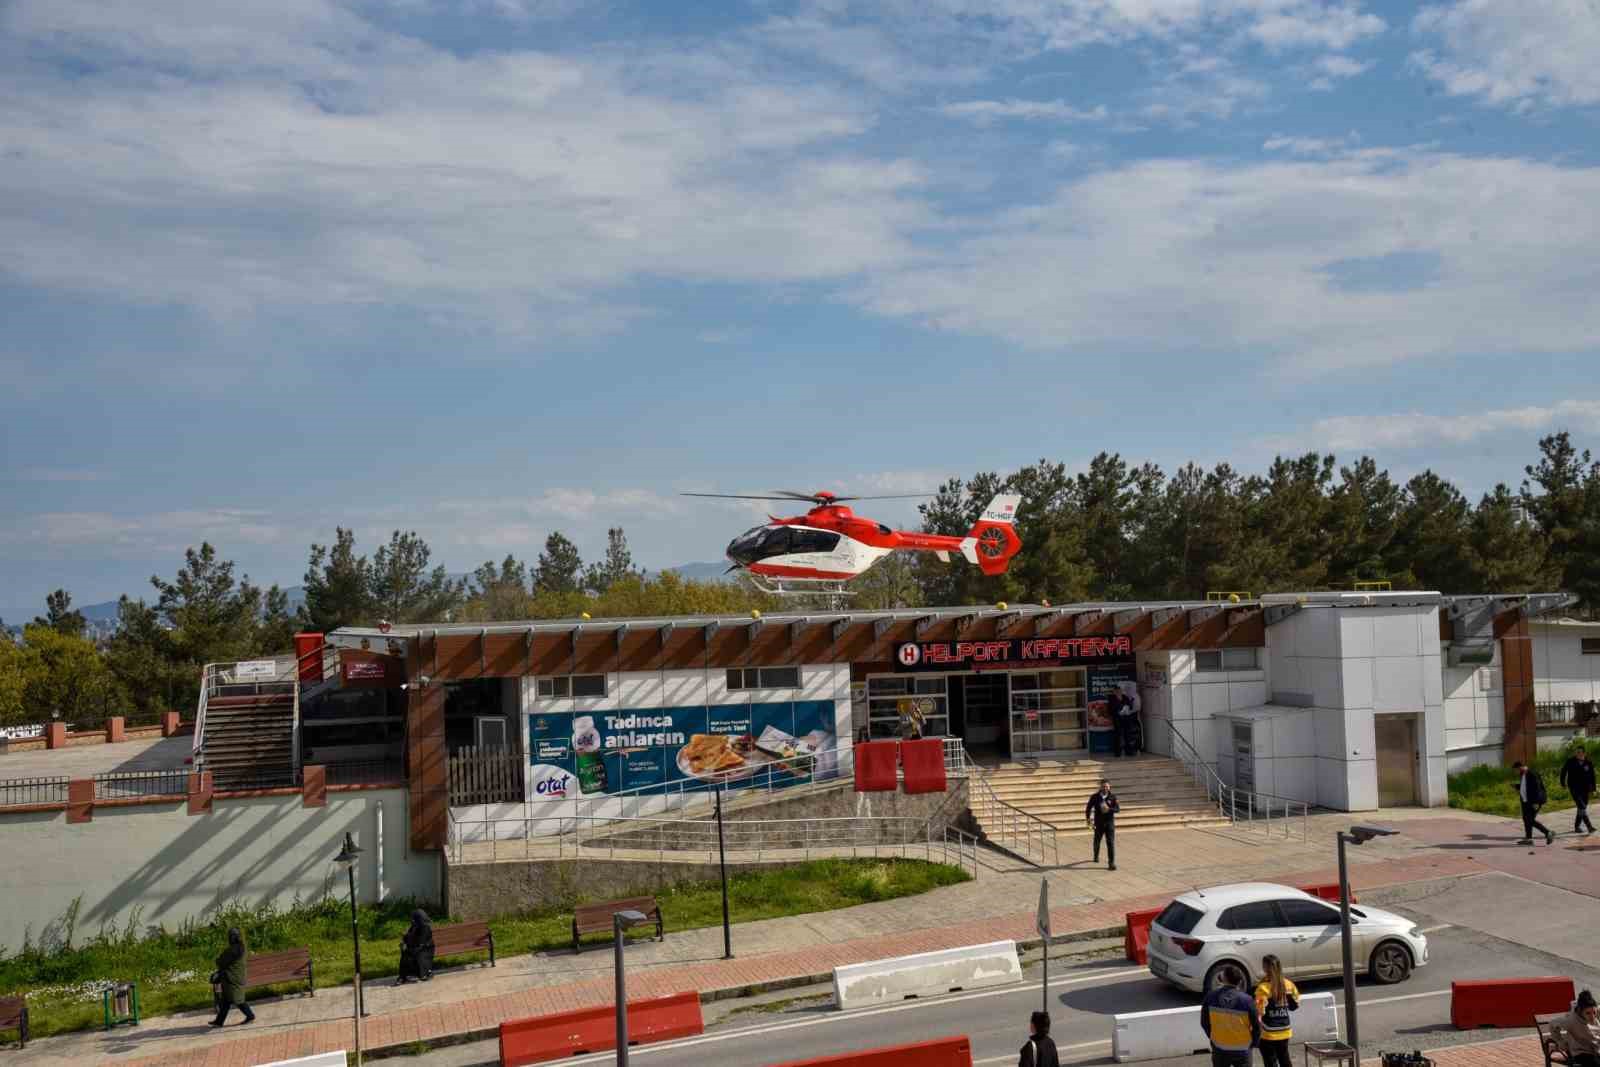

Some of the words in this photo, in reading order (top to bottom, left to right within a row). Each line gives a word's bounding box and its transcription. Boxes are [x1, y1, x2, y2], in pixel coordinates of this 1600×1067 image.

[903, 647, 914, 661] H
[1021, 636, 1131, 659] KAFETERYA
[605, 714, 672, 730] Tadınca
[605, 731, 685, 748] anlarsın
